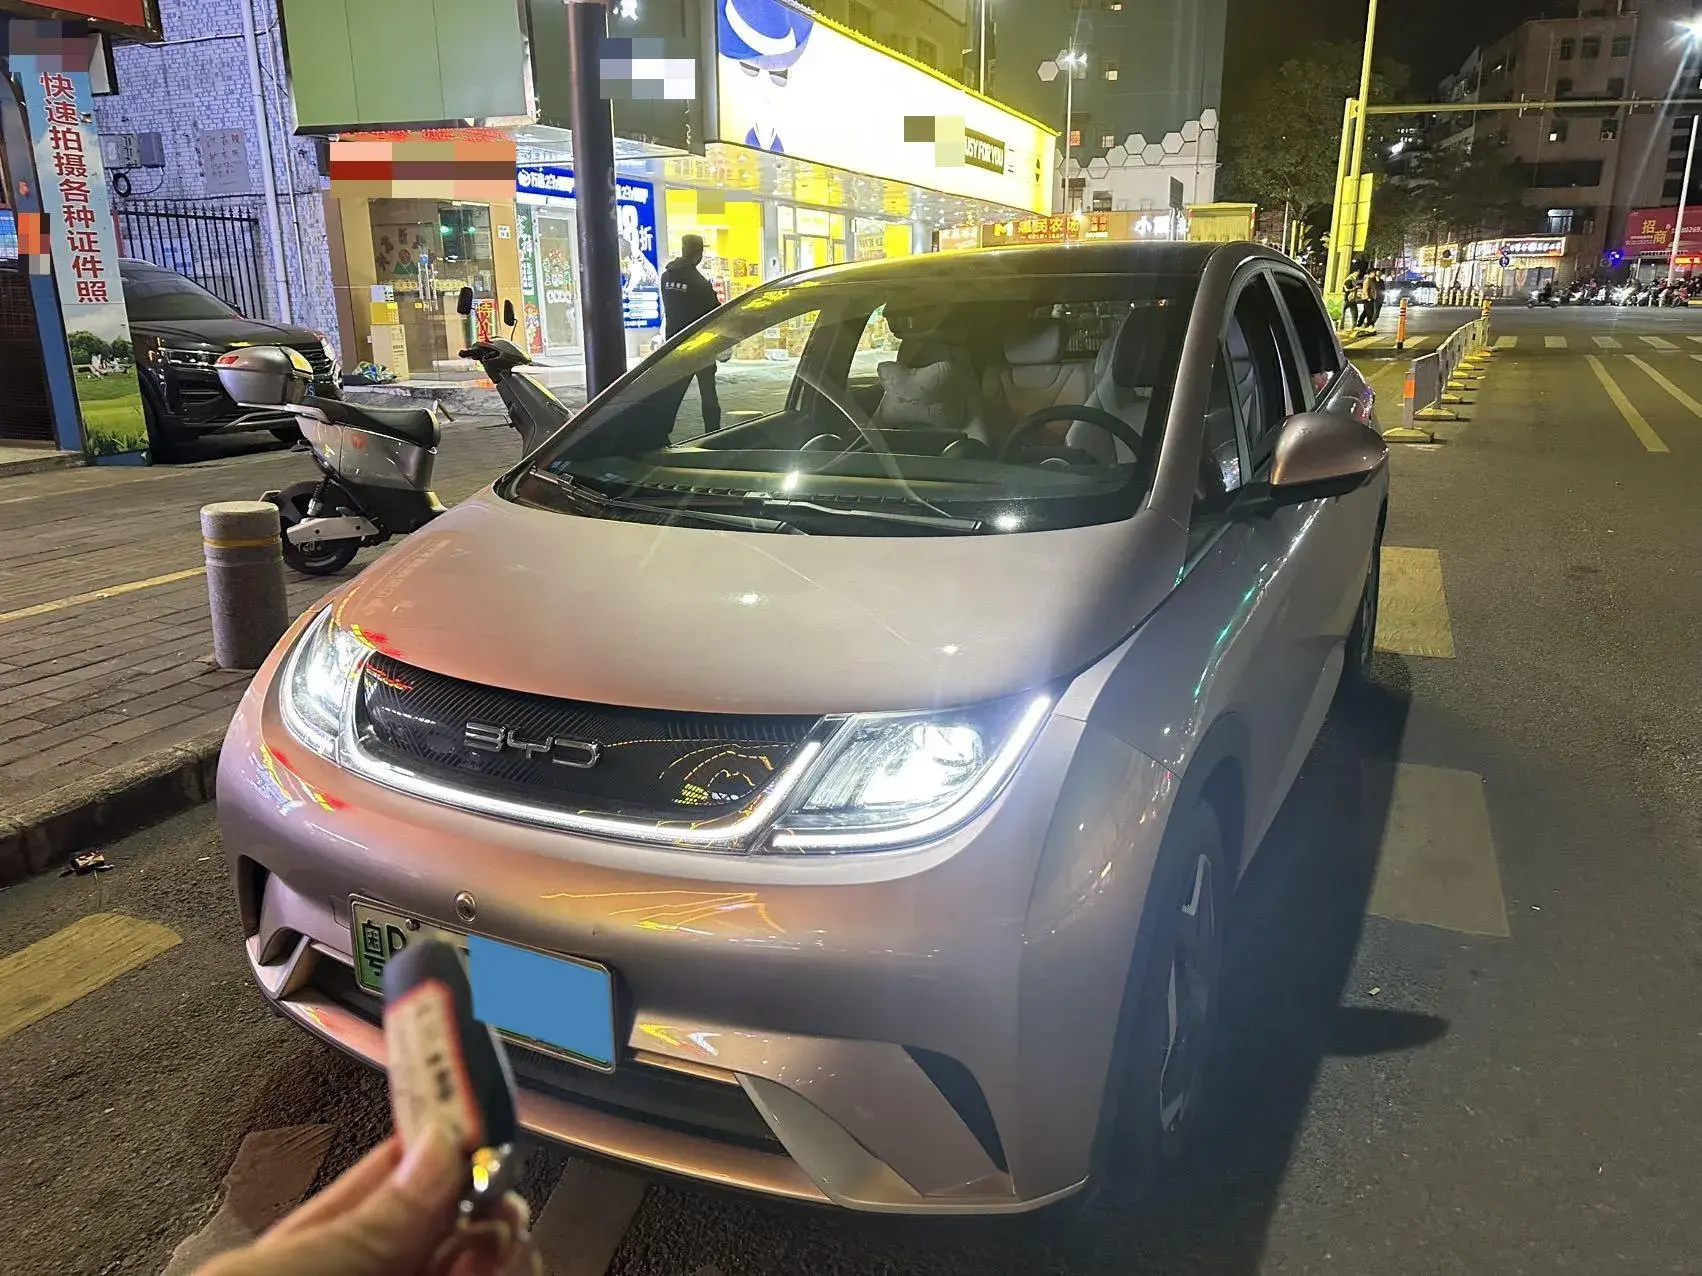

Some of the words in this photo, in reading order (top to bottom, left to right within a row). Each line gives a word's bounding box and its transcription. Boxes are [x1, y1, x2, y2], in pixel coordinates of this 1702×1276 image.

[978, 140, 991, 162] FOR
[991, 146, 1004, 167] YOU
[40, 71, 109, 303] 快速拍摄各种证件照
[1641, 219, 1668, 244] 招商
[463, 721, 600, 768] BYD
